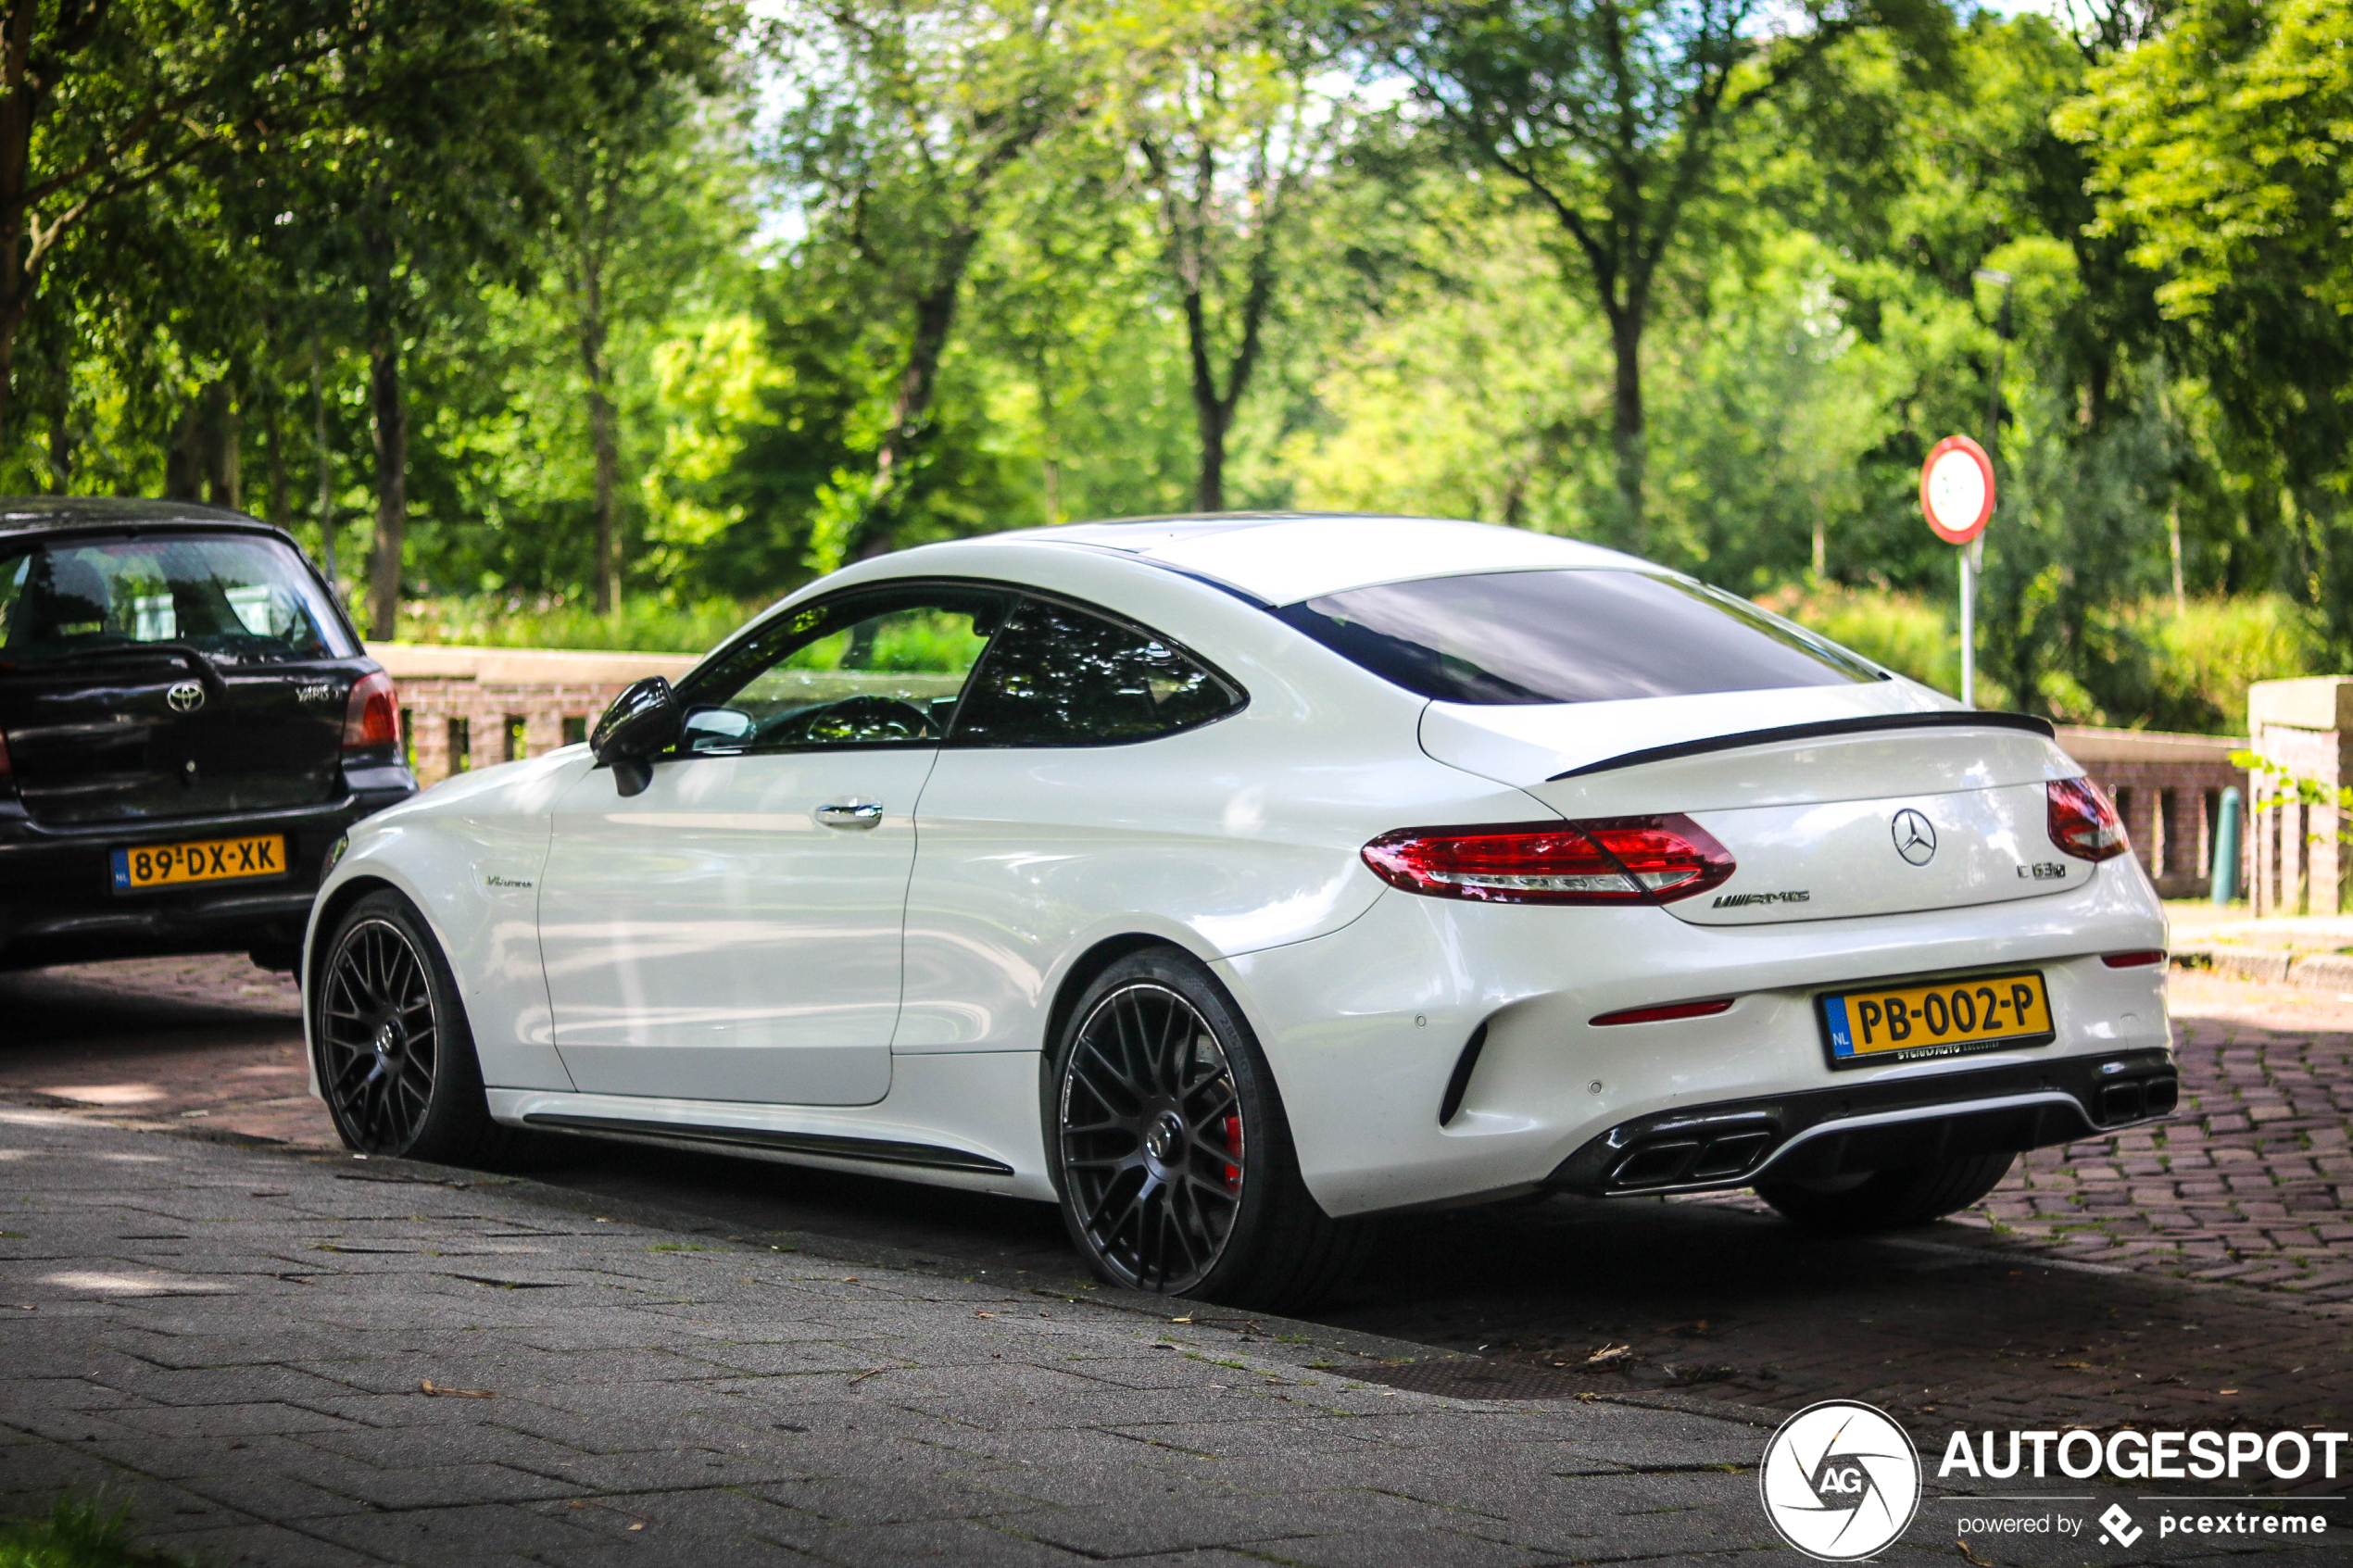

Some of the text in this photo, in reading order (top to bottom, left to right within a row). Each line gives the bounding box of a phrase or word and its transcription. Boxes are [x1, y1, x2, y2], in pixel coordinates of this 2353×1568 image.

[296, 685, 329, 702] YARIS
[1858, 983, 2033, 1044] PB-002-P
[1833, 1032, 1849, 1046] NL
